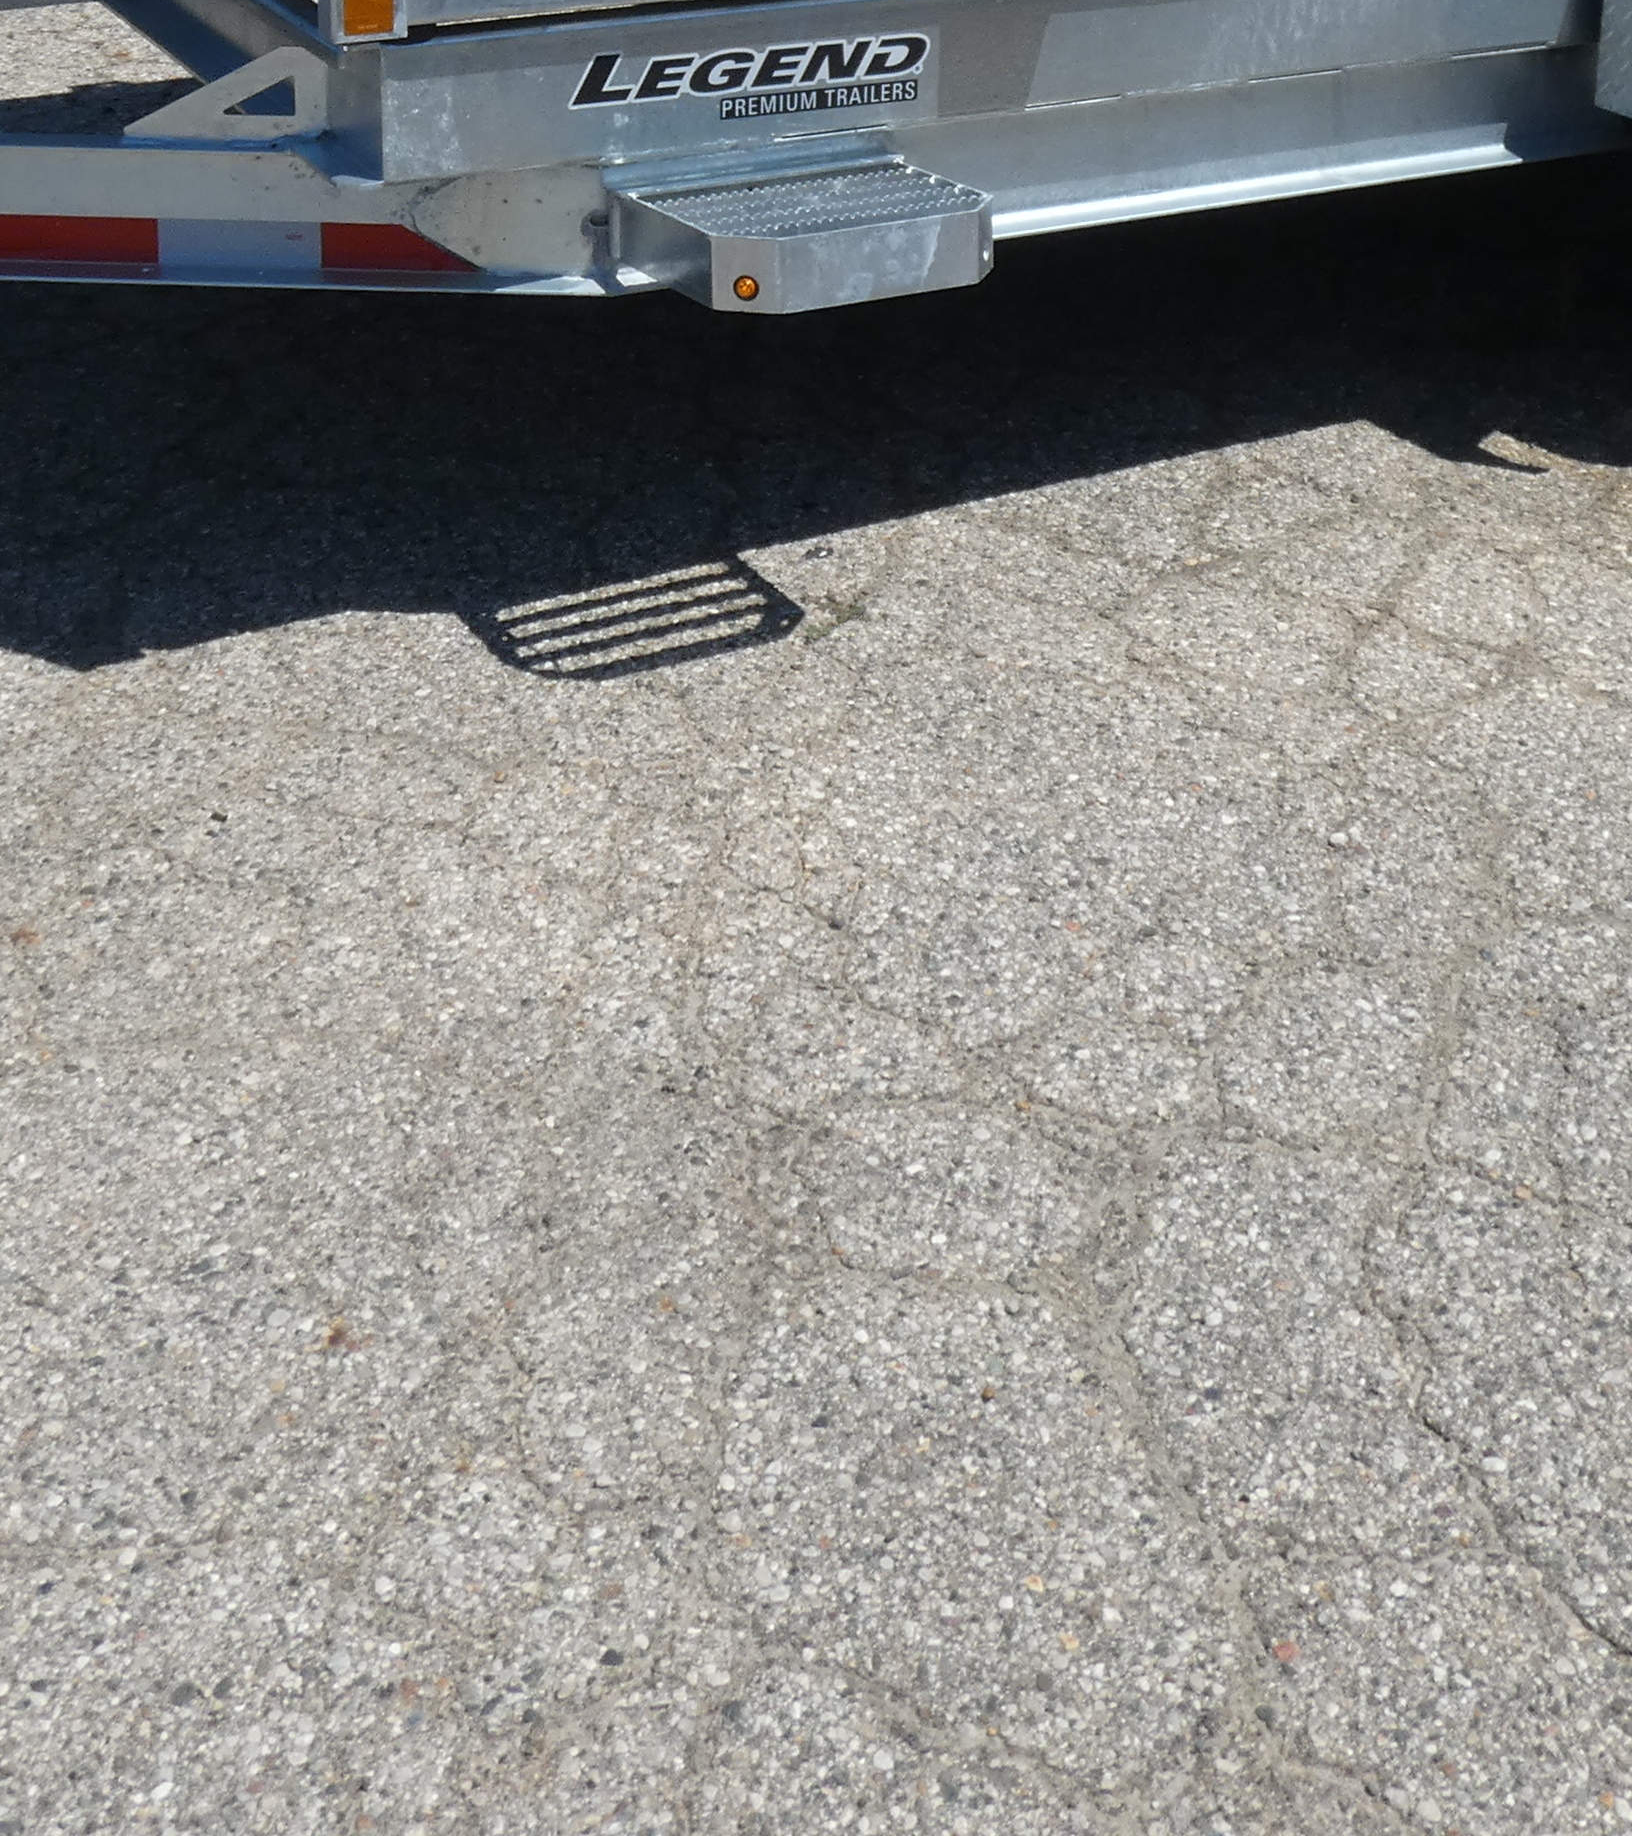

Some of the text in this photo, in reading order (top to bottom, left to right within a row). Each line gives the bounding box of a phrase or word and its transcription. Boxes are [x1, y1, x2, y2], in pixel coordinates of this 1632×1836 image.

[569, 33, 930, 108] LEGEND
[721, 81, 917, 119] PREMIUM TRAILERS
